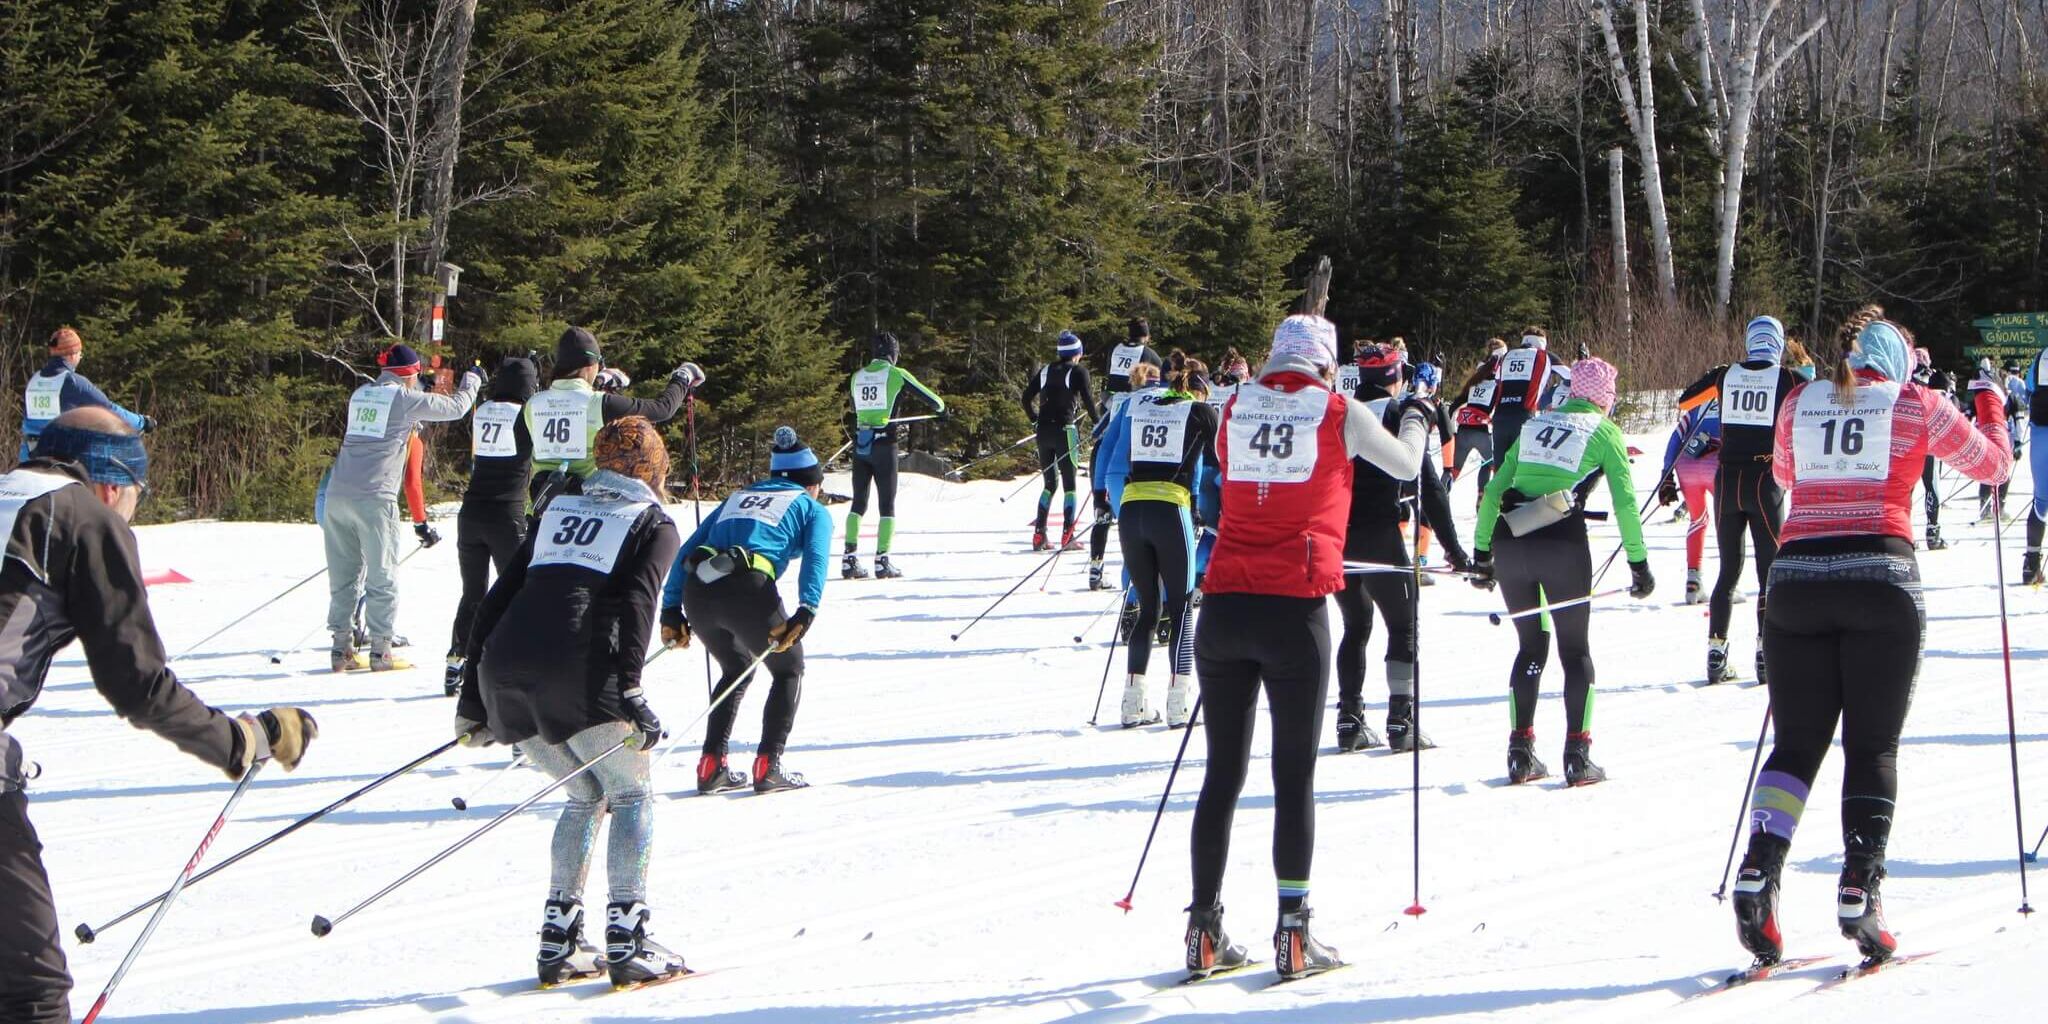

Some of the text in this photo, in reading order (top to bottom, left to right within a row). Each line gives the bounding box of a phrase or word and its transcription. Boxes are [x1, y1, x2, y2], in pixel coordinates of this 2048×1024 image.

[1993, 315, 2029, 325] VILLAGE
[1986, 331, 2035, 344] GNOMES
[1118, 356, 1132, 369] 76
[1510, 361, 1526, 372] 55
[1342, 378, 1358, 390] 80
[862, 386, 878, 401] 93
[1731, 390, 1768, 412] 100
[33, 396, 50, 408] 133
[356, 408, 377, 423] 139
[1236, 413, 1281, 421] RANGELEY
[1852, 408, 1888, 416] LOPPET
[481, 422, 502, 444] 27
[543, 418, 570, 443] 46
[1141, 425, 1169, 448] 63
[1536, 426, 1572, 450] 47
[1820, 418, 1865, 455] 16
[1249, 423, 1294, 459] 43
[739, 496, 775, 509] 64
[552, 515, 604, 546] 30
